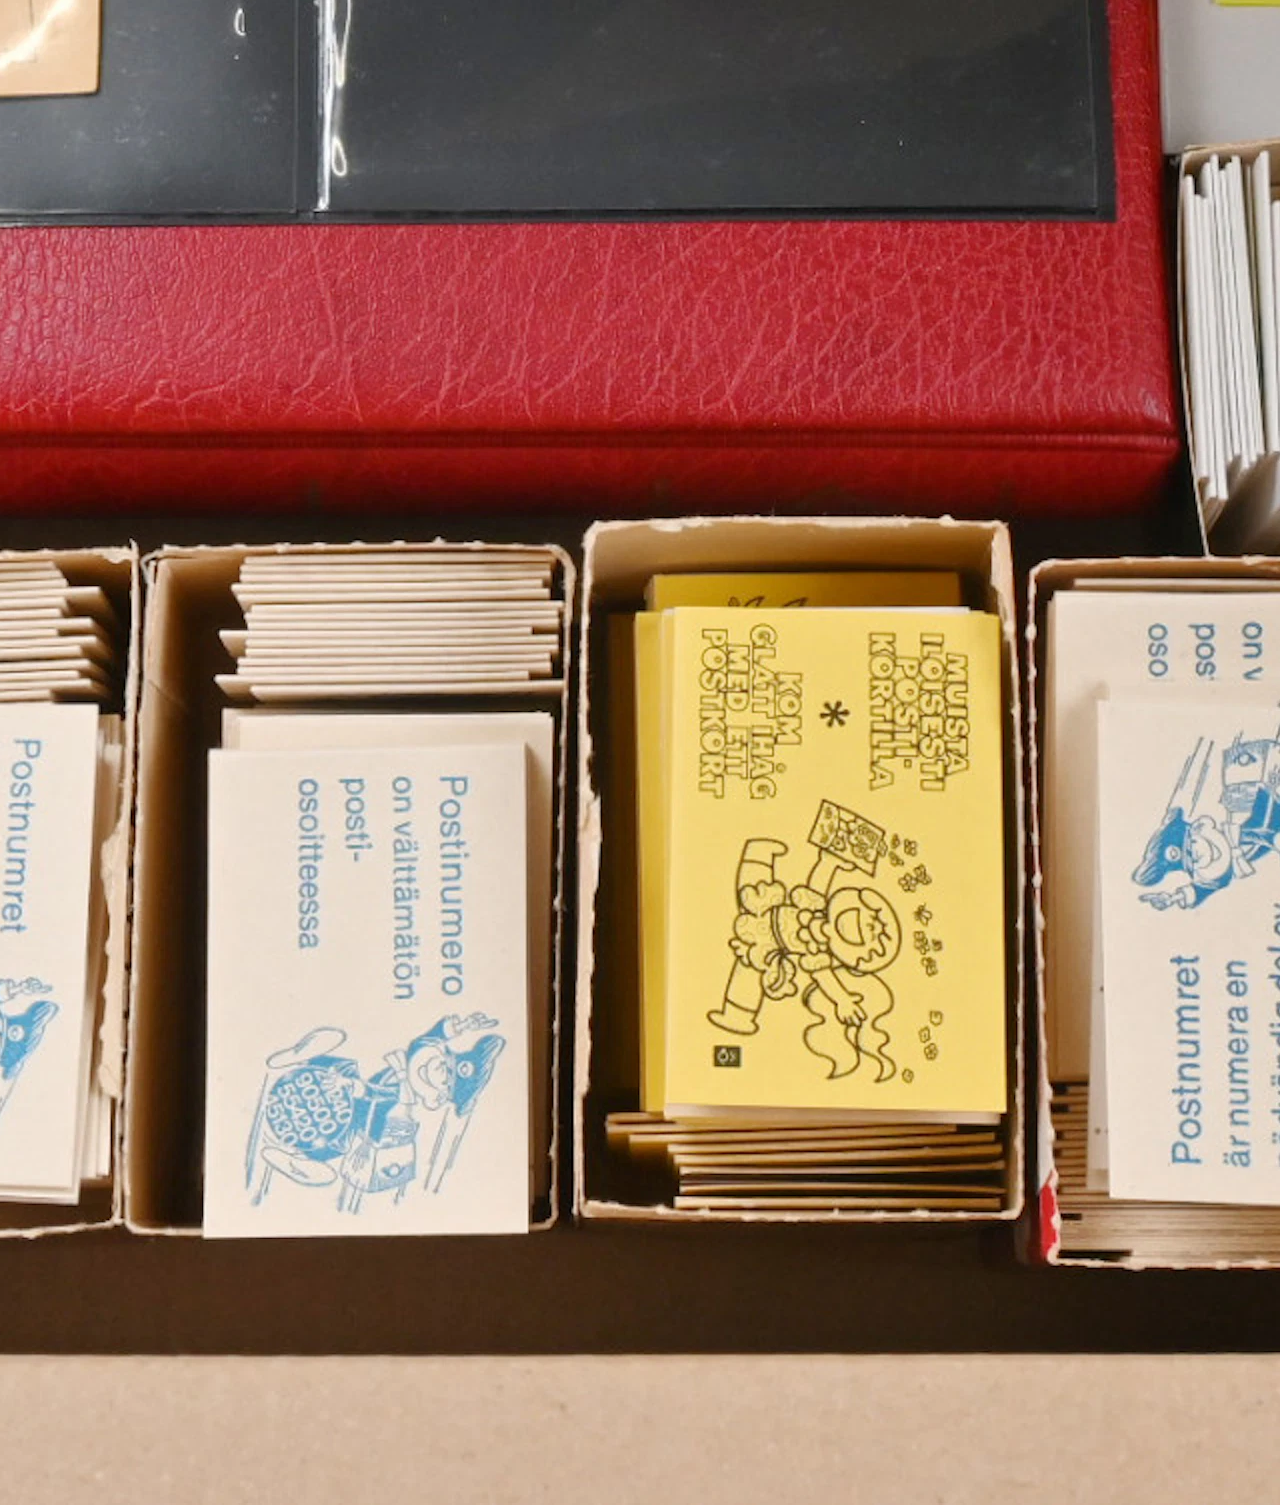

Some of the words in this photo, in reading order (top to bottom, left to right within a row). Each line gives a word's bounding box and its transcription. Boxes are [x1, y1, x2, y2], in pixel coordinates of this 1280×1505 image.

[726, 642, 749, 711] MED
[1147, 623, 1168, 677] oso
[1242, 621, 1263, 659] on
[698, 628, 728, 799] POSTKORT
[774, 671, 803, 745] KOM
[868, 632, 896, 791] KORTILLA
[920, 632, 945, 791] ILOISESTI
[942, 652, 970, 778] MUISTA
[0, 737, 43, 933] Postnumret
[339, 777, 373, 862] posti-
[392, 775, 413, 813] on
[297, 777, 327, 949] osoitteessa
[392, 821, 421, 1001] välttämätön
[438, 774, 471, 997] Postinumero
[1226, 960, 1248, 997] en
[1170, 955, 1202, 1164] Postnumret
[1227, 1006, 1251, 1127] numera
[1222, 1135, 1251, 1168] är
